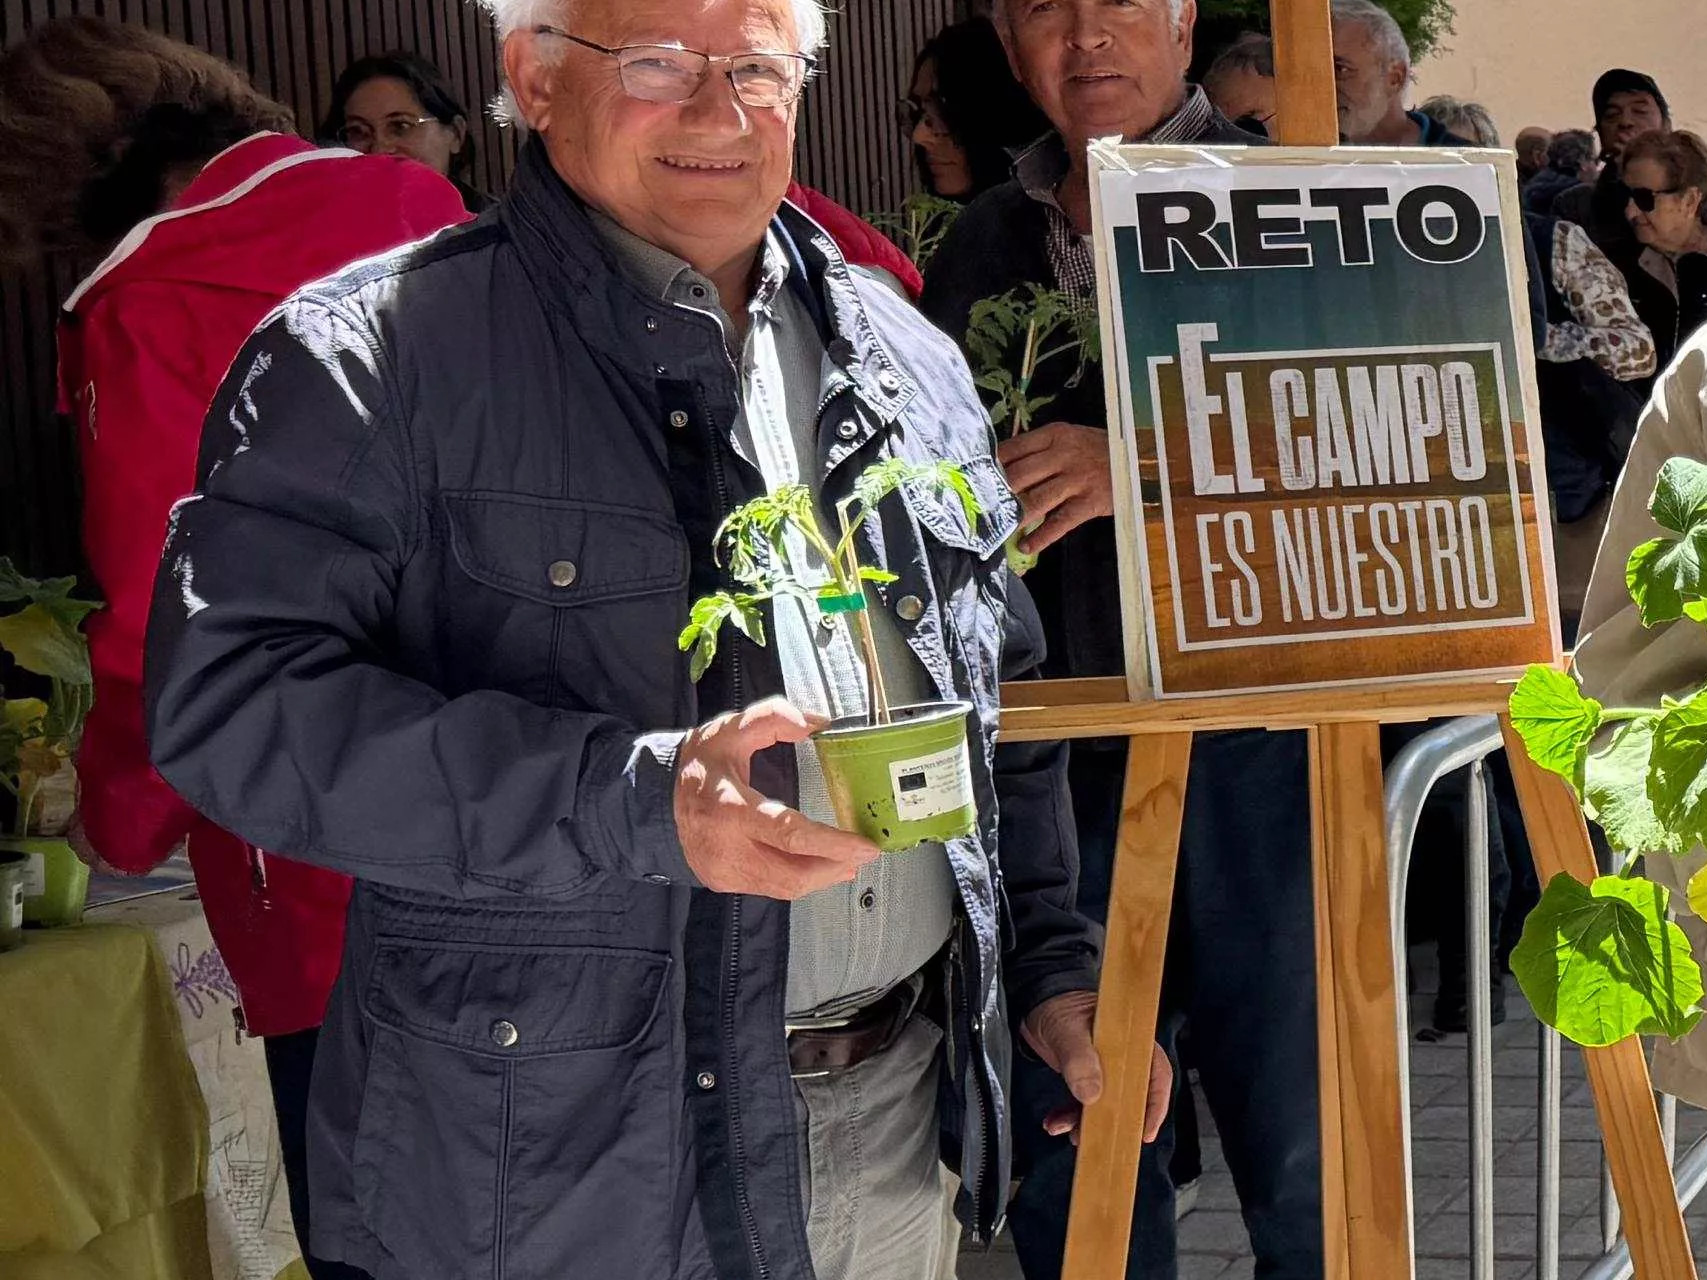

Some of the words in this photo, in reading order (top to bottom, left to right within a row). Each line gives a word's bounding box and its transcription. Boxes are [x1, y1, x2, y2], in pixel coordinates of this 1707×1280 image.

[1136, 185, 1485, 272] RETO
[1270, 361, 1487, 491] CAMPO
[1196, 511, 1263, 628] ES
[1272, 495, 1499, 623] NUESTRO
